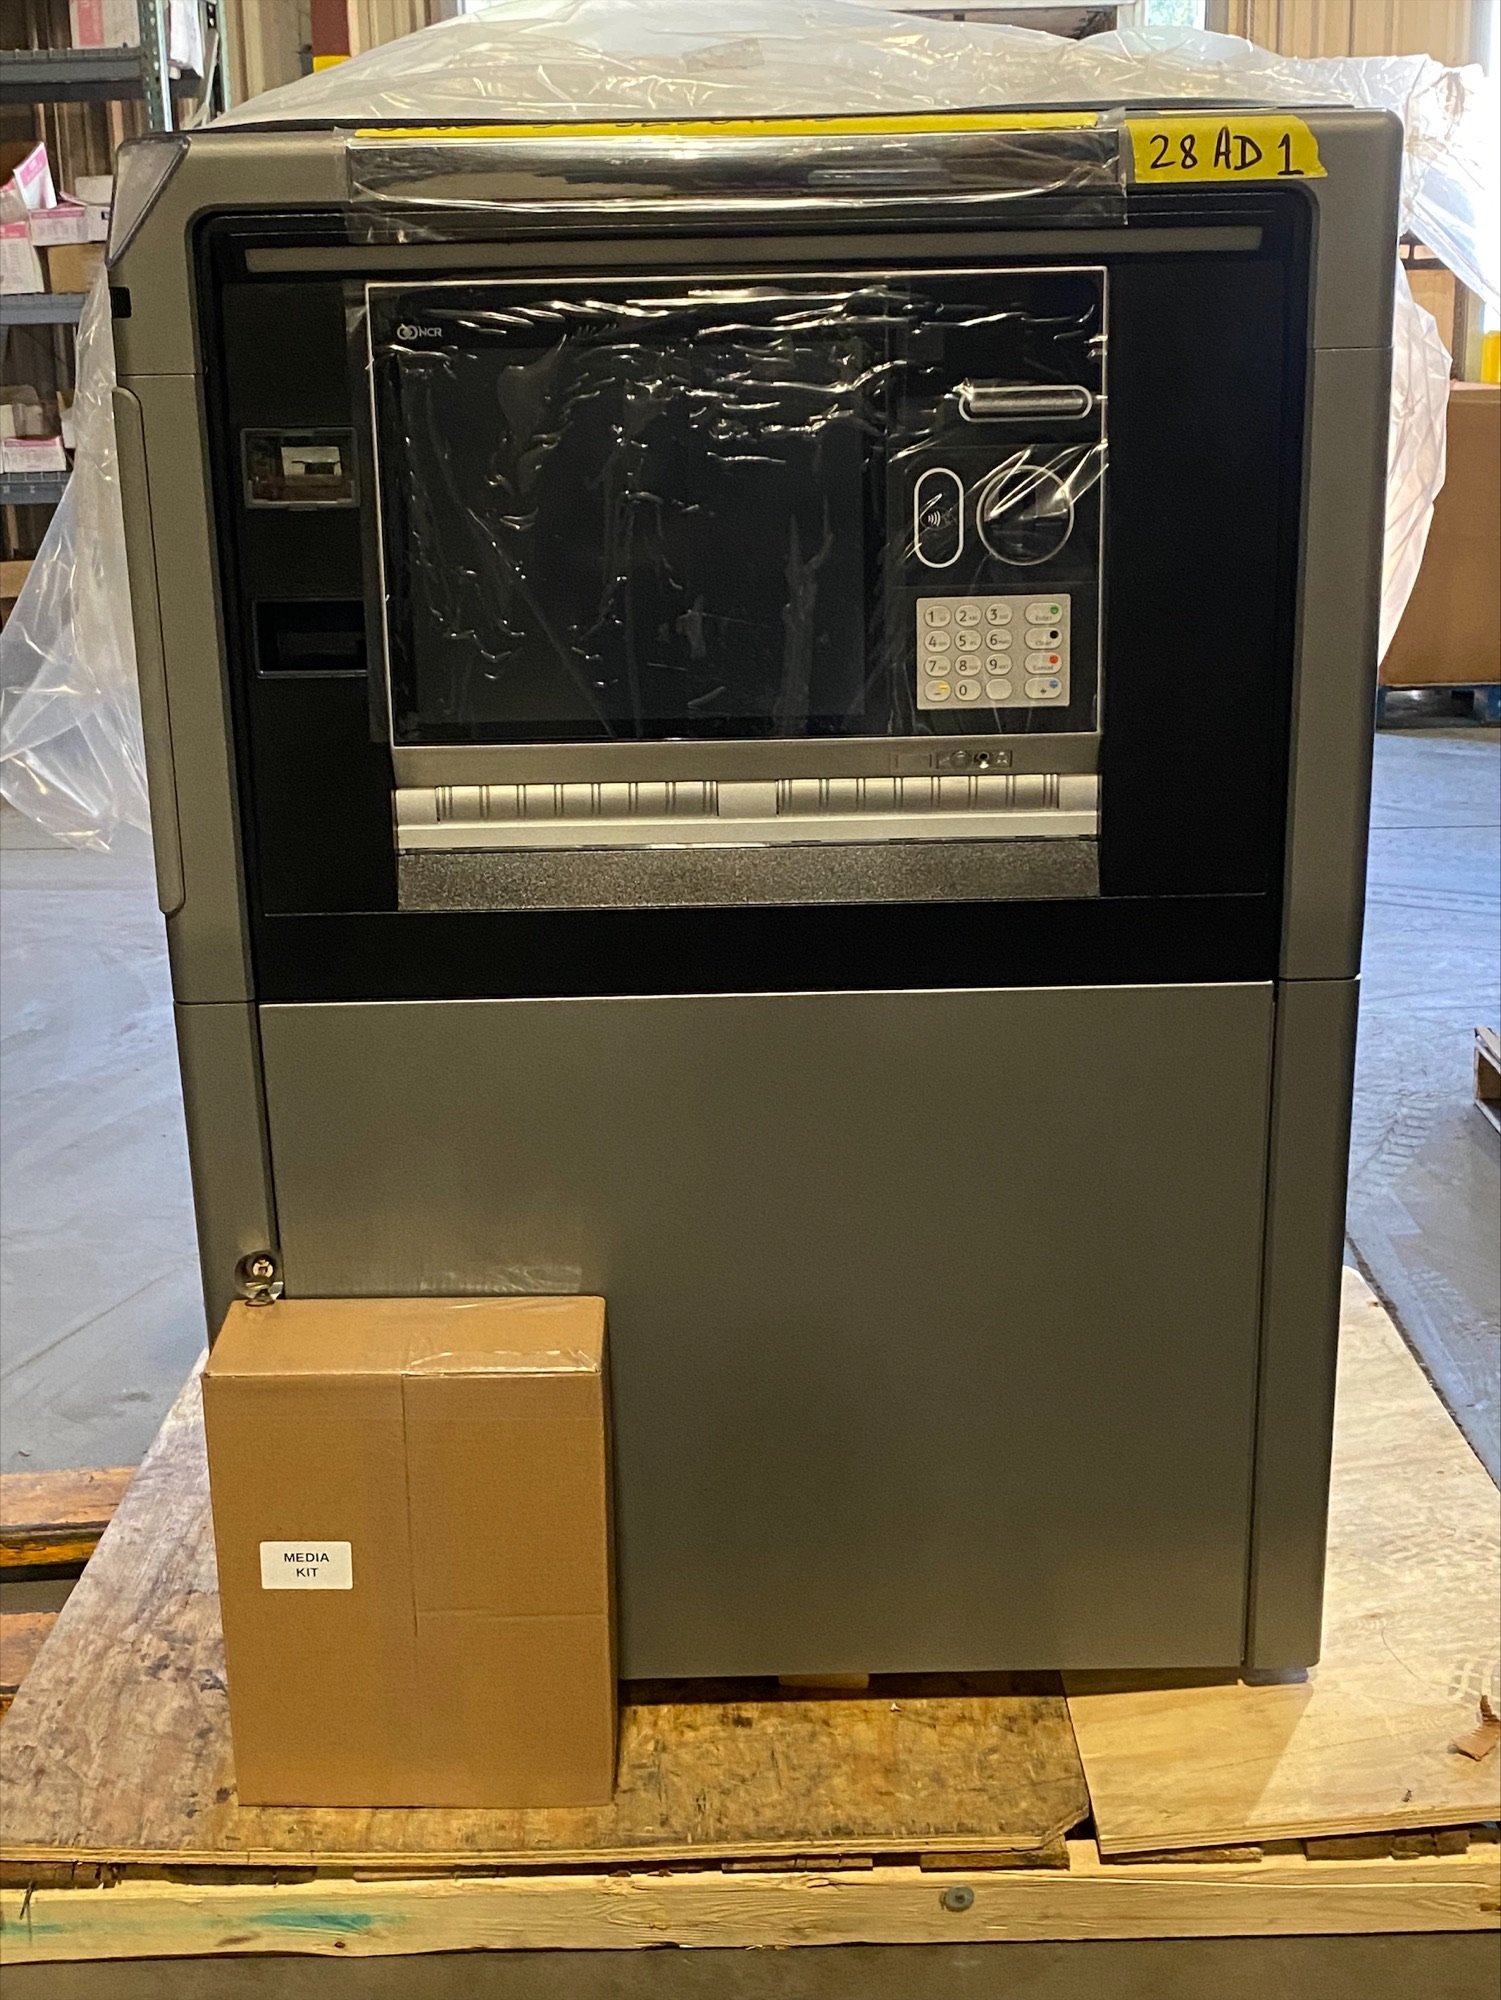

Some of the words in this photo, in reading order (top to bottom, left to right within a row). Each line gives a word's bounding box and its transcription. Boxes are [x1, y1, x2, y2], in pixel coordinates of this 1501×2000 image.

[1150, 134, 1198, 169] 28
[1213, 125, 1263, 171] AD
[1277, 133, 1305, 176] 1
[418, 326, 442, 337] NCR
[928, 610, 934, 623] 1
[959, 610, 967, 622] 2
[990, 608, 998, 621] 3
[928, 635, 937, 648] 4
[959, 635, 966, 647] 5
[990, 633, 998, 646] 6
[928, 660, 937, 673] 7
[959, 660, 967, 672] 8
[989, 658, 998, 671] 9
[959, 684, 968, 696] 0
[283, 1552, 330, 1562] MEDIA
[296, 1567, 318, 1577] KIT
